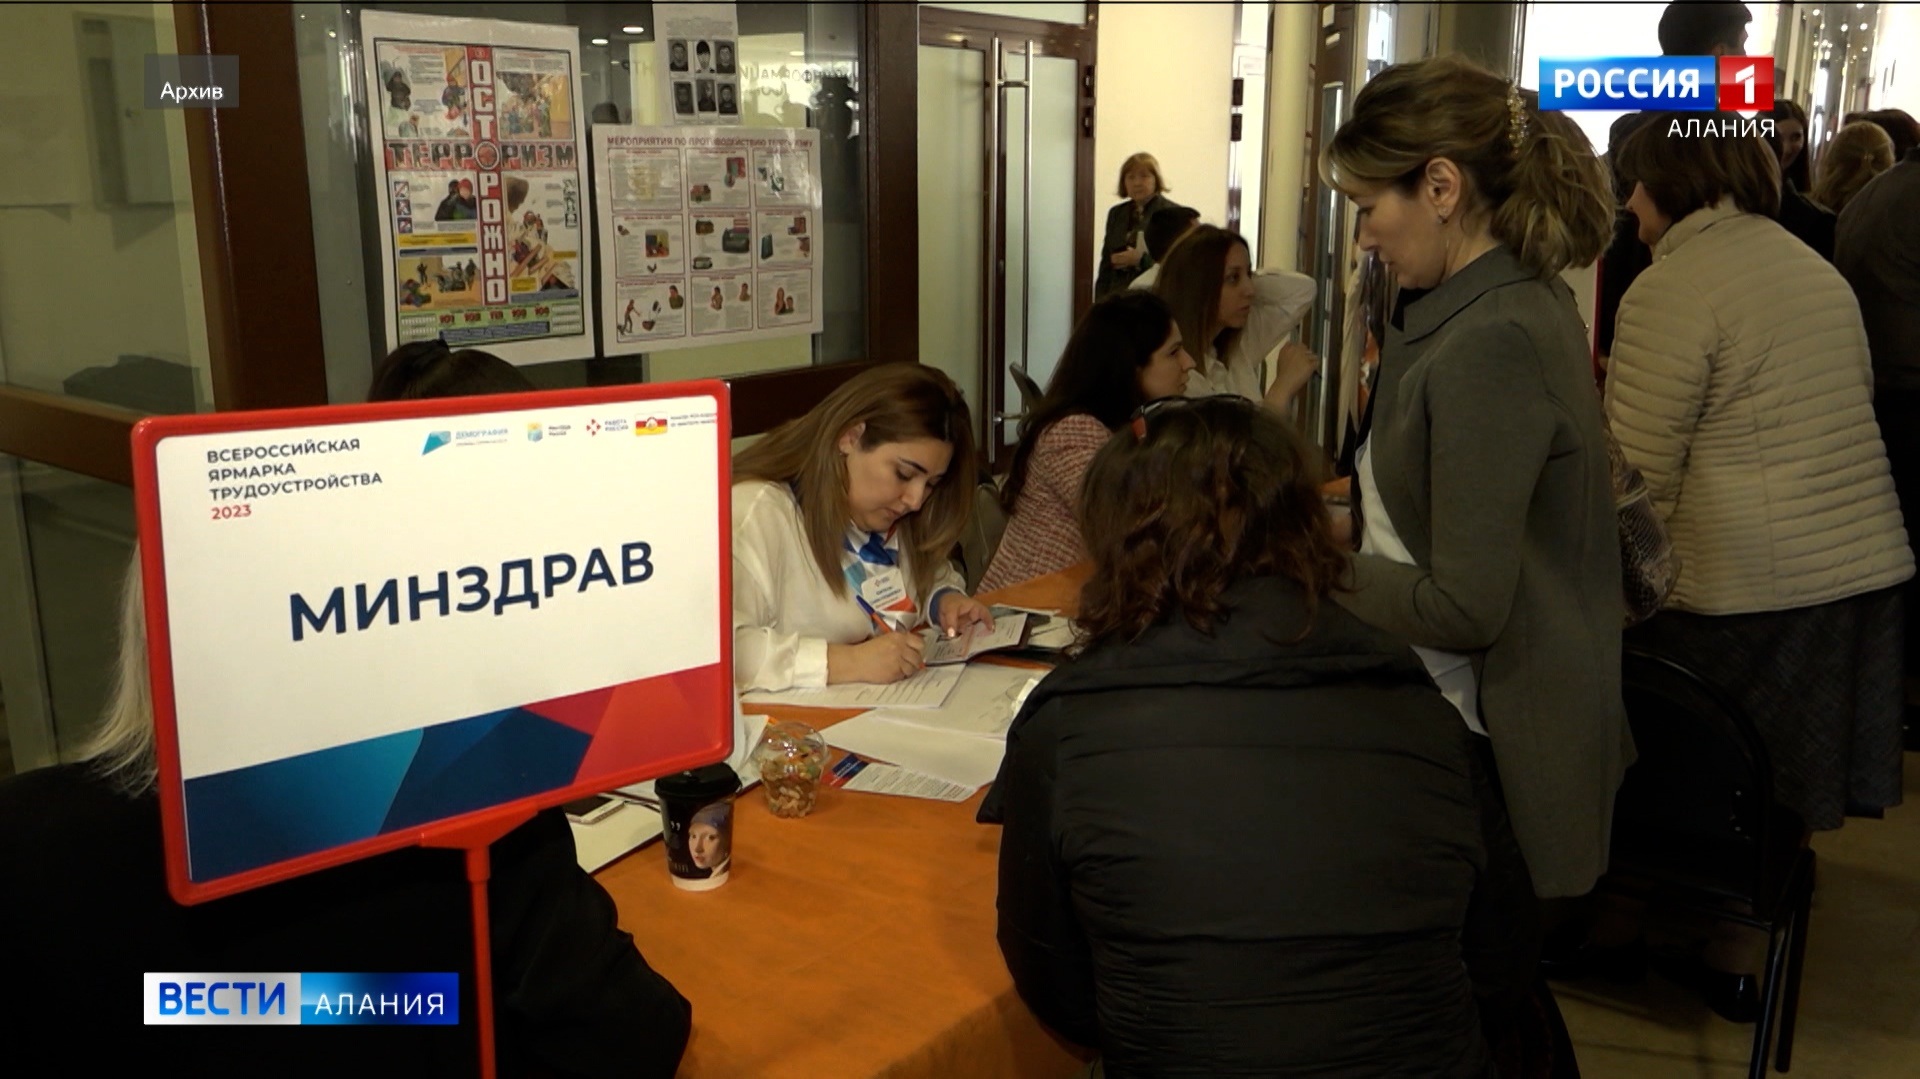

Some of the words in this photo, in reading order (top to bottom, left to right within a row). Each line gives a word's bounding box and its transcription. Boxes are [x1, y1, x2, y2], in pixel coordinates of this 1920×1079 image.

[607, 136, 673, 146] МЕРОПРИЯТИЯ
[674, 137, 687, 146] ПО
[689, 138, 765, 147] ПРОТВОДЕЙСТВИЮ
[387, 141, 575, 170] ТЕРРОРИЗМ
[207, 438, 361, 464] ВСЕРОССИЙСКАЯ
[208, 462, 297, 482] ЯРМАРКА
[209, 472, 383, 501] ТРУДОУСТРОЙСТВА
[211, 504, 252, 520] 2023
[290, 541, 655, 641] МИНЗДРАВ
